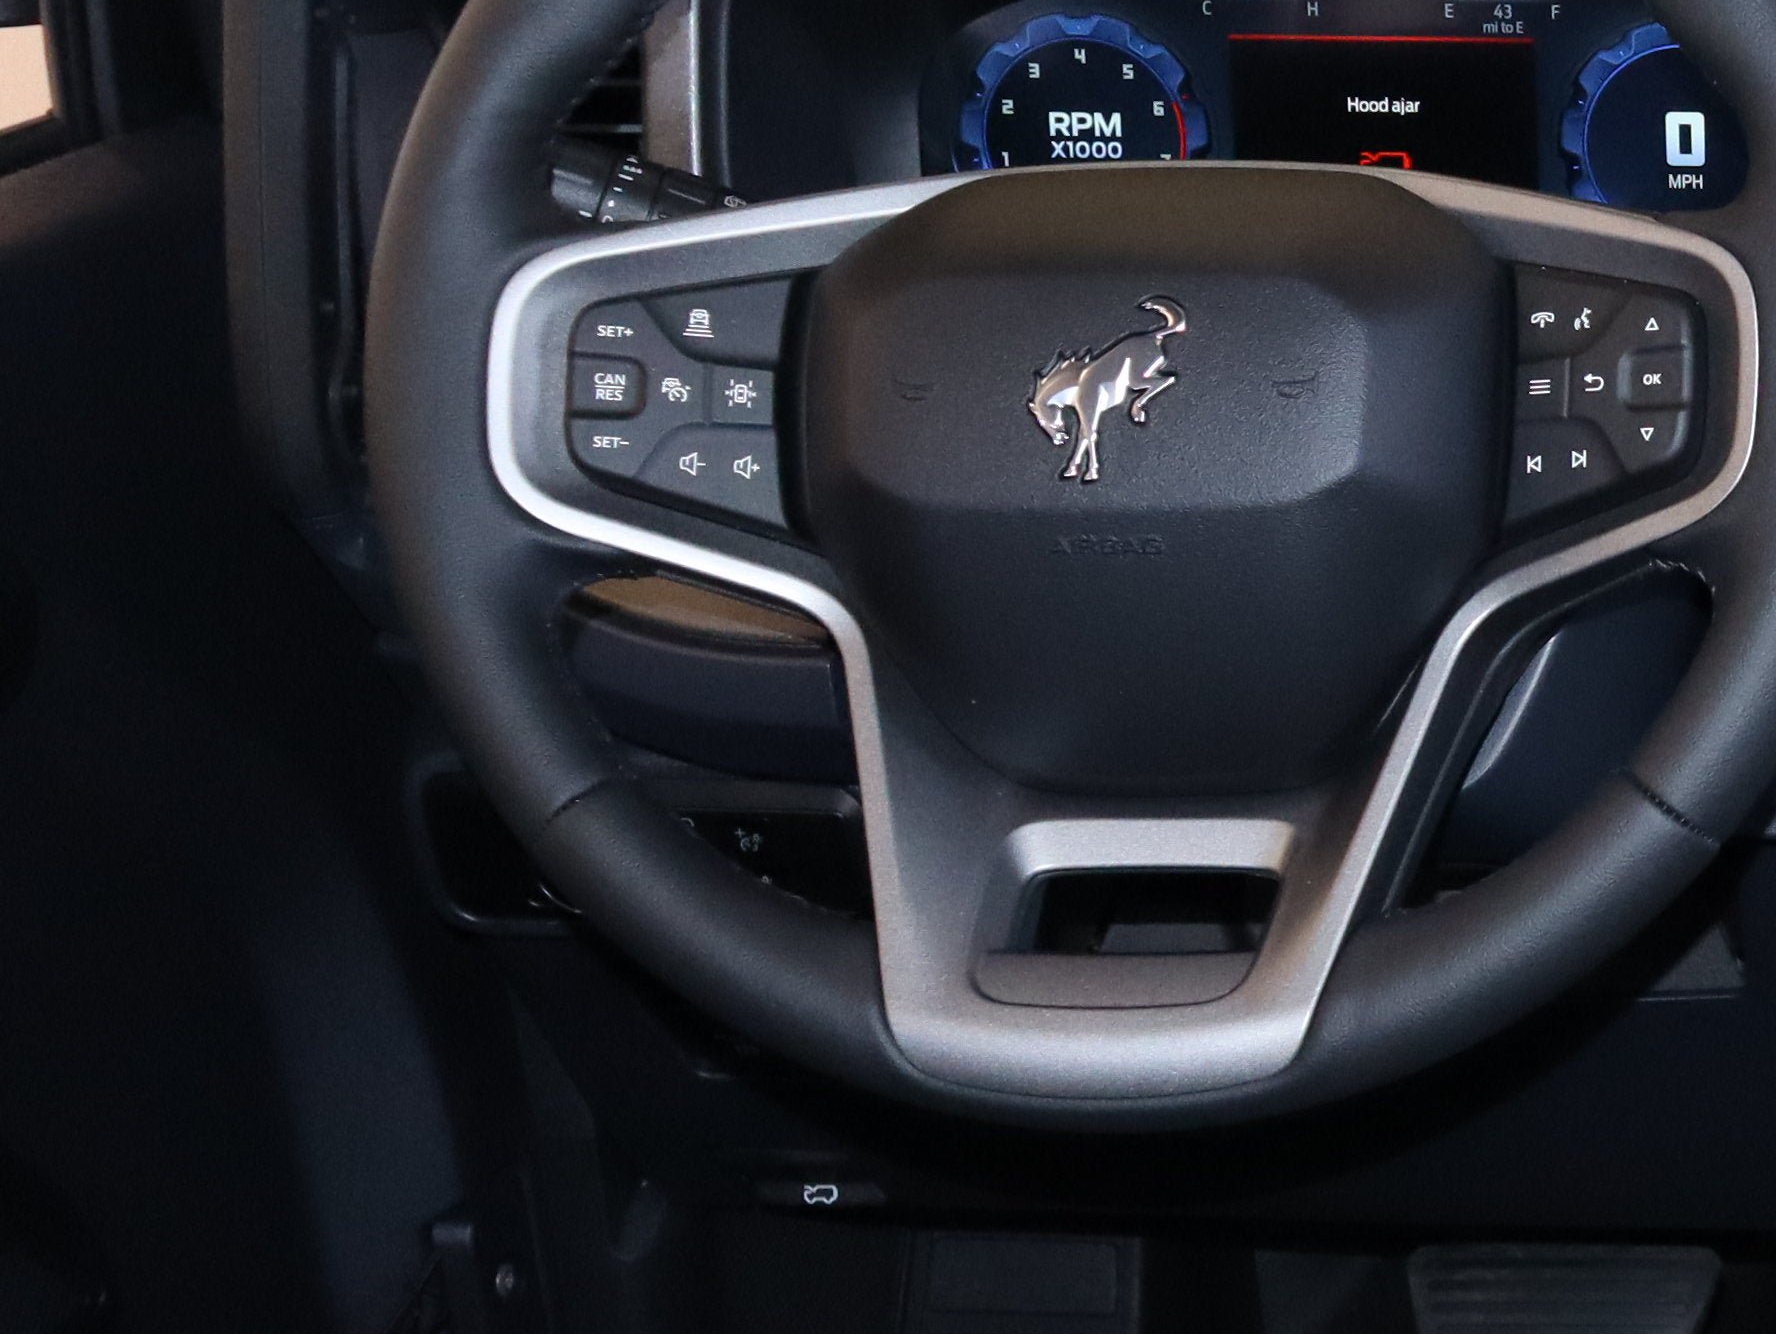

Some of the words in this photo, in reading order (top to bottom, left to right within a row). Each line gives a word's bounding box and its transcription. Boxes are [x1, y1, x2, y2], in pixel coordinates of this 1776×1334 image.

[1202, 0, 1212, 16] C
[1307, 2, 1319, 17] H
[1445, 4, 1454, 19] E
[1493, 4, 1513, 19] 43
[1551, 5, 1560, 19] F
[1483, 21, 1498, 34] mi
[1501, 22, 1513, 34] to
[1516, 22, 1524, 34] E
[1074, 48, 1086, 64] 4
[1028, 63, 1040, 78] 3
[1122, 64, 1134, 79] 5
[1002, 99, 1014, 114] 2
[1153, 101, 1164, 116] 6
[1347, 97, 1389, 113] Hood
[1392, 98, 1420, 116] ajar
[1049, 112, 1122, 137] RPM
[1665, 111, 1706, 167] 0
[1051, 141, 1123, 159] X1000
[1668, 174, 1703, 189] MPH
[597, 325, 634, 338] SET+
[594, 373, 626, 385] CAN
[1643, 374, 1662, 385] OK
[595, 389, 623, 401] RES
